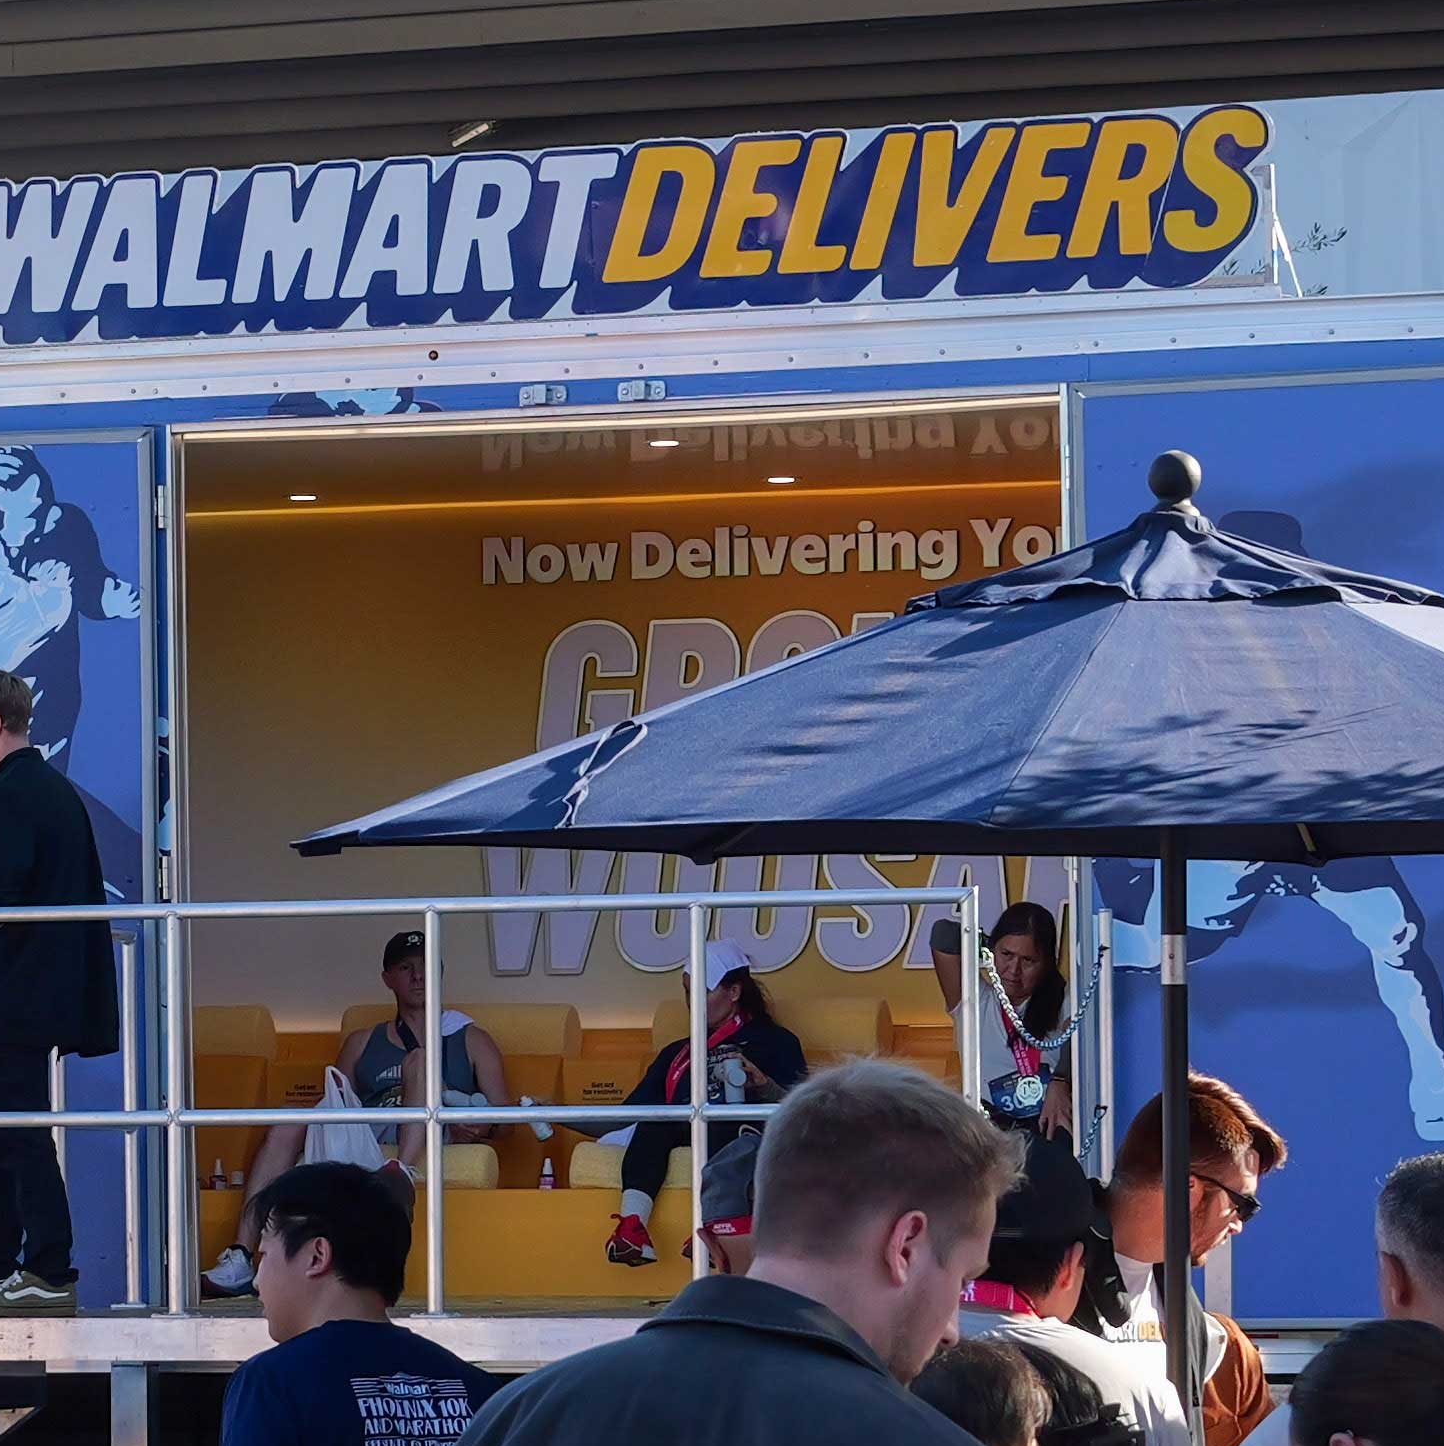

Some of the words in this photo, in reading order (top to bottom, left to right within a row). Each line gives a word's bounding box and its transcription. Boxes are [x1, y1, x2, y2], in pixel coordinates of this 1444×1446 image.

[482, 536, 618, 585] Now
[630, 520, 960, 580] Delivering
[969, 517, 1062, 568] Yo
[357, 1396, 437, 1418] PHOENIX
[437, 1397, 473, 1418] 10K
[364, 1417, 393, 1435] AND
